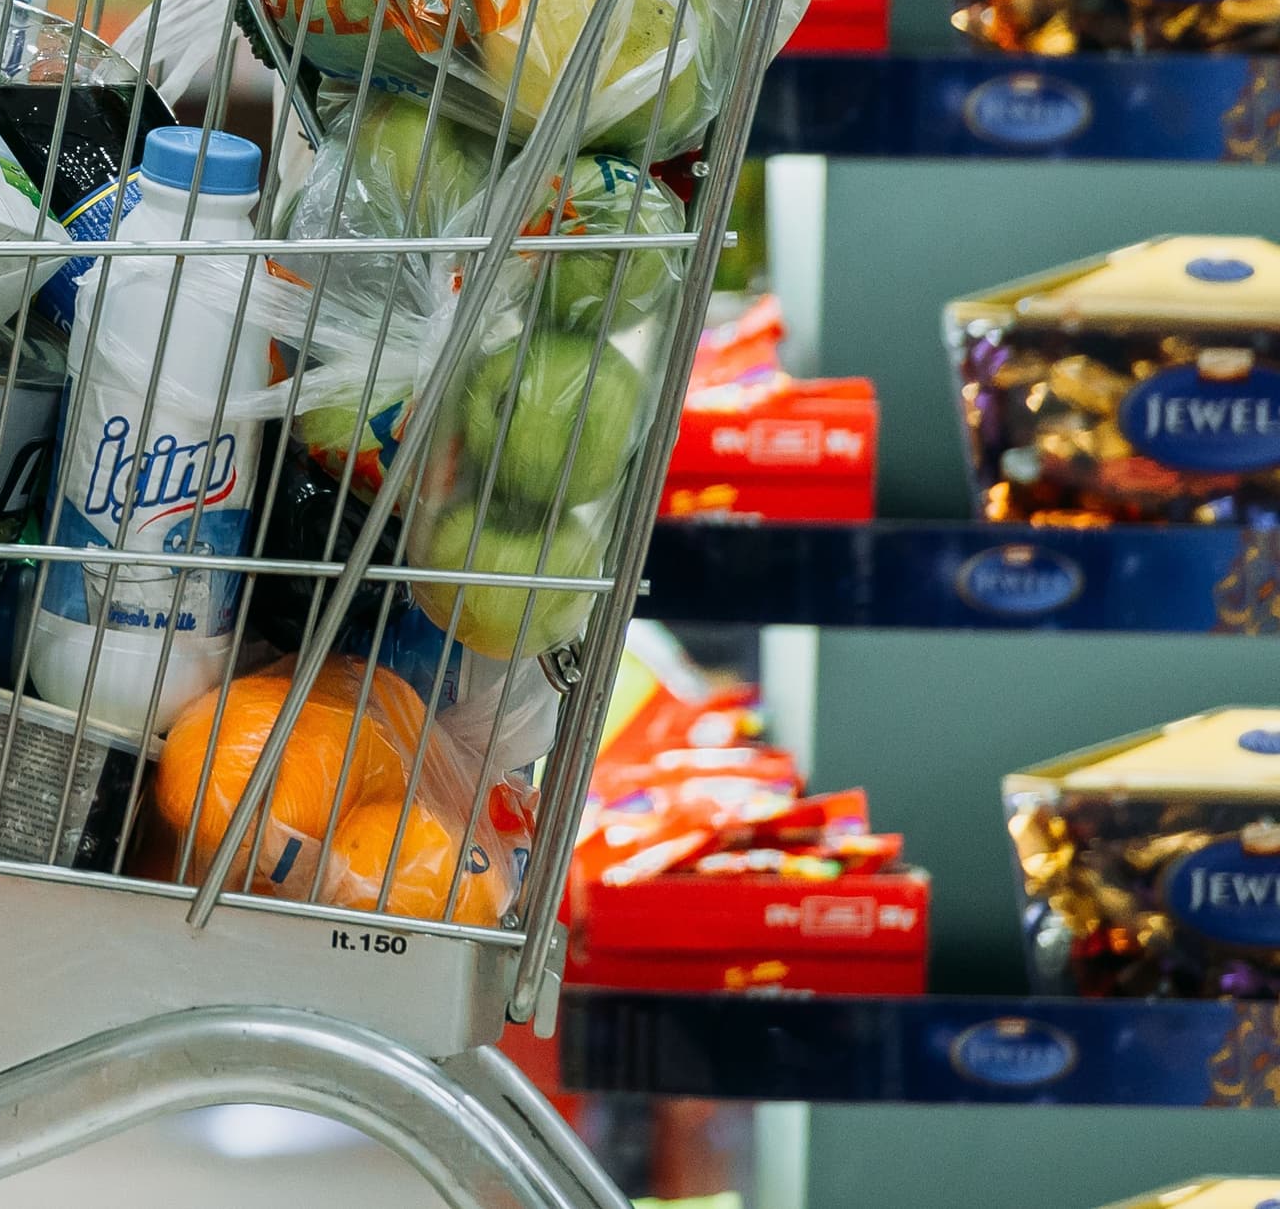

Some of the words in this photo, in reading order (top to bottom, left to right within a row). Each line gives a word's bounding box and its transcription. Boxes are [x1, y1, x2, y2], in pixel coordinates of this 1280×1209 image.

[1146, 393, 1280, 439] JEWEL
[110, 608, 150, 628] resh
[154, 611, 196, 631] Mlk
